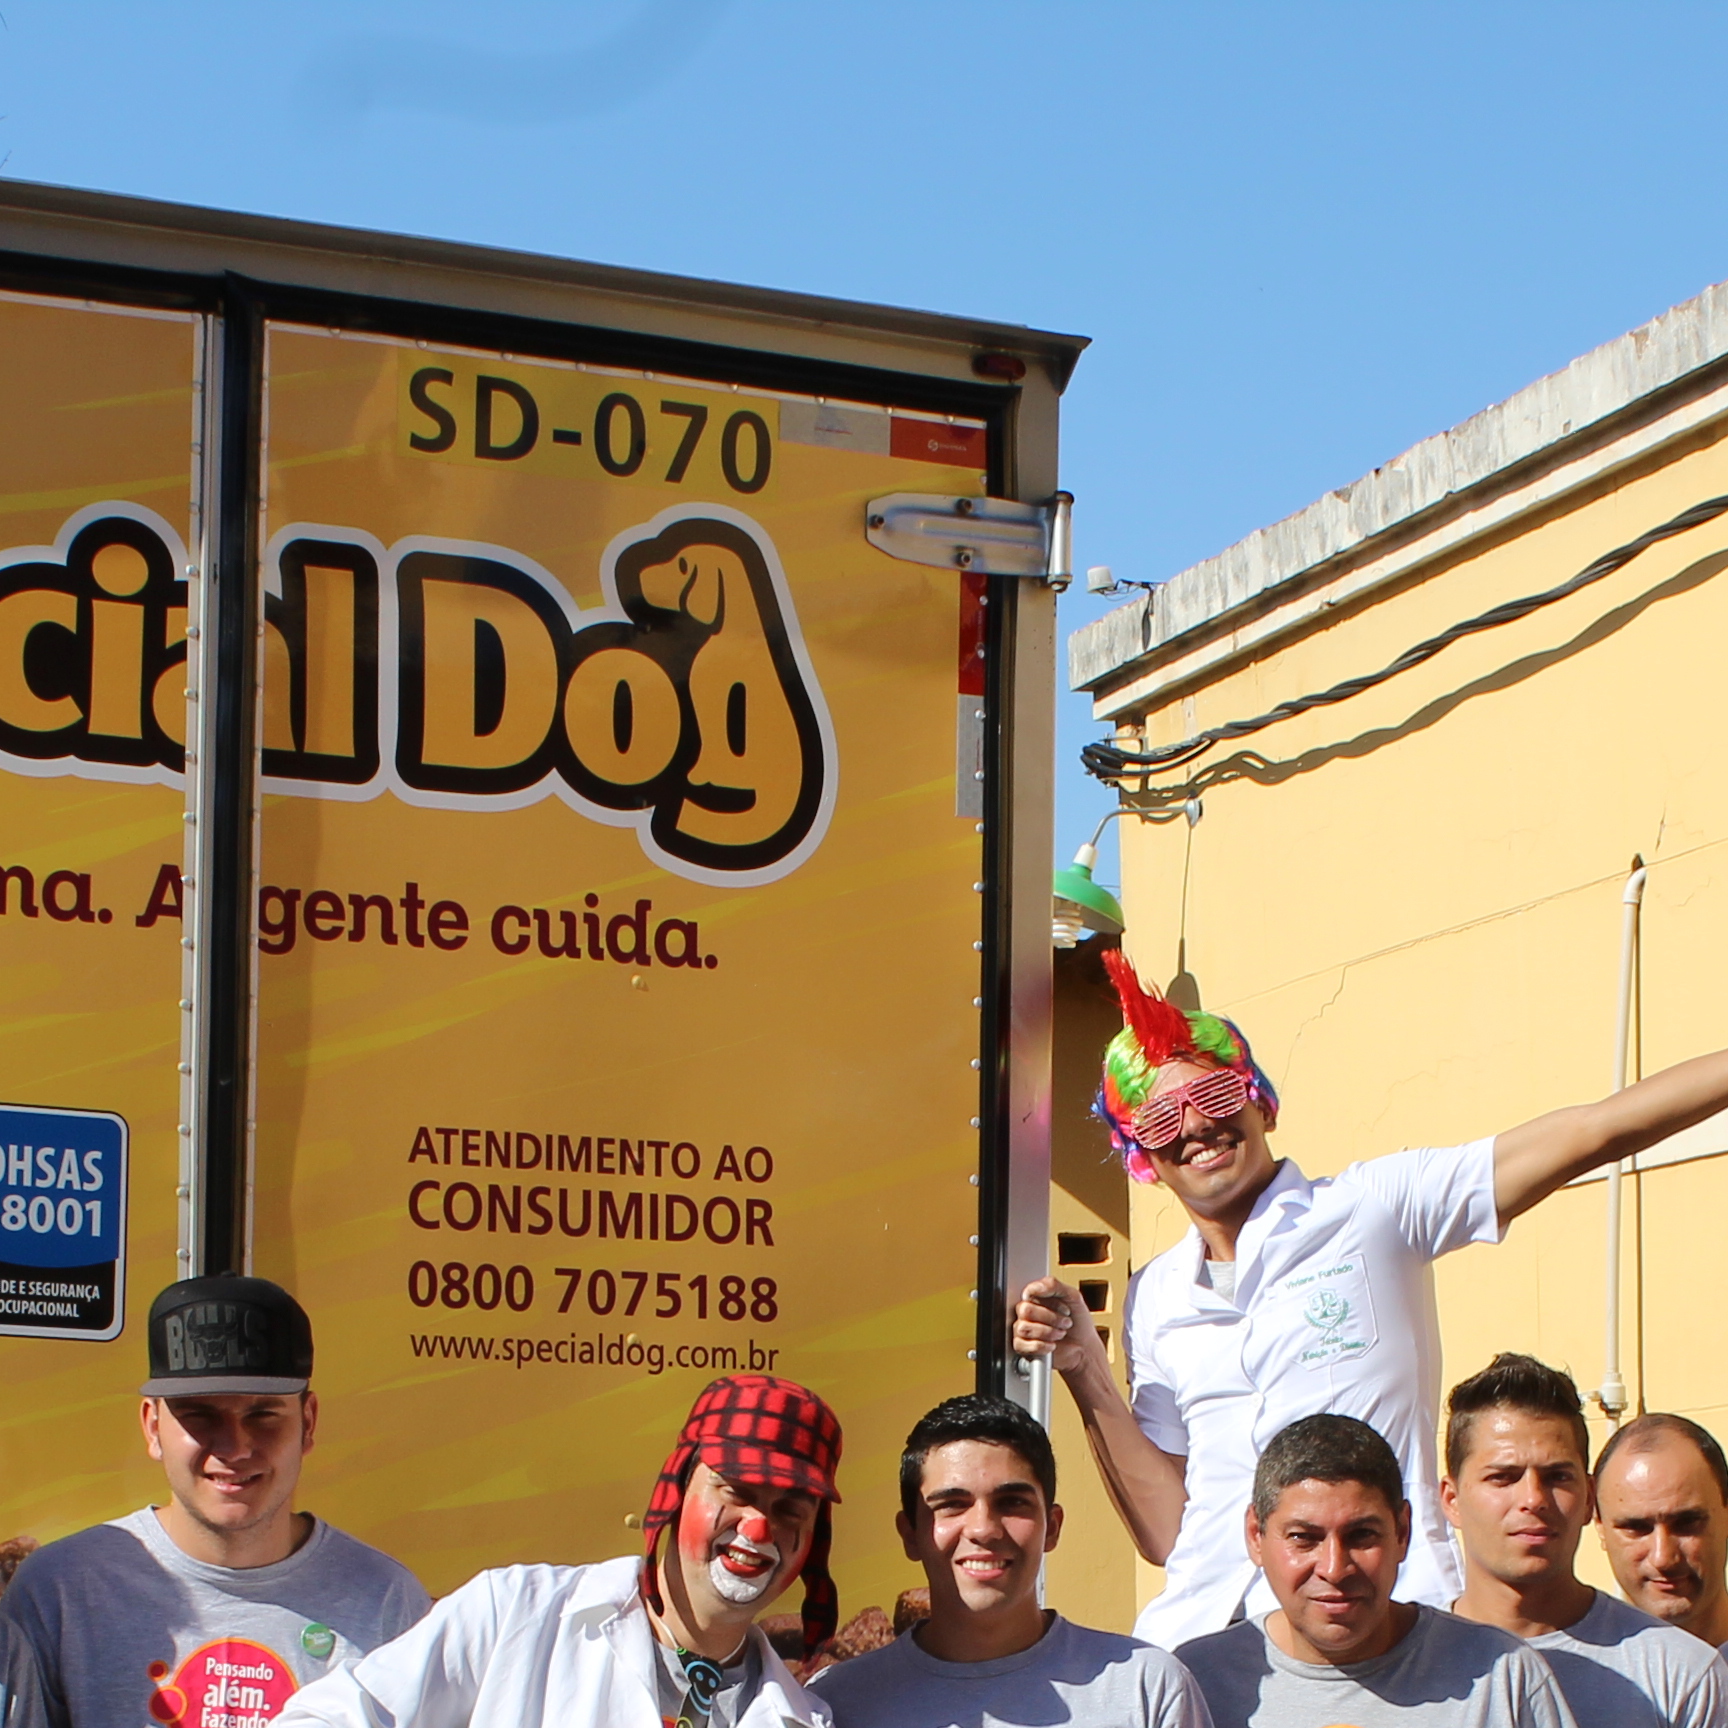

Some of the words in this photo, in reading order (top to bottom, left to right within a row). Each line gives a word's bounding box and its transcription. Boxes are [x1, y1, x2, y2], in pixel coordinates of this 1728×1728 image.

[408, 367, 773, 496] SD-070
[396, 517, 825, 871] Dog
[135, 863, 186, 929] A
[255, 880, 470, 956] gente
[490, 891, 718, 971] cuida.
[407, 1126, 702, 1180] ATENDIMENTO
[712, 1143, 774, 1184] AO
[407, 1179, 775, 1247] CONSUMIDOR
[19, 1281, 27, 1296] E
[28, 1281, 101, 1302] SEGURANÇA
[407, 1260, 535, 1313] 0800
[553, 1266, 779, 1323] 7075188
[409, 1330, 780, 1376] www.specialdog.com.br
